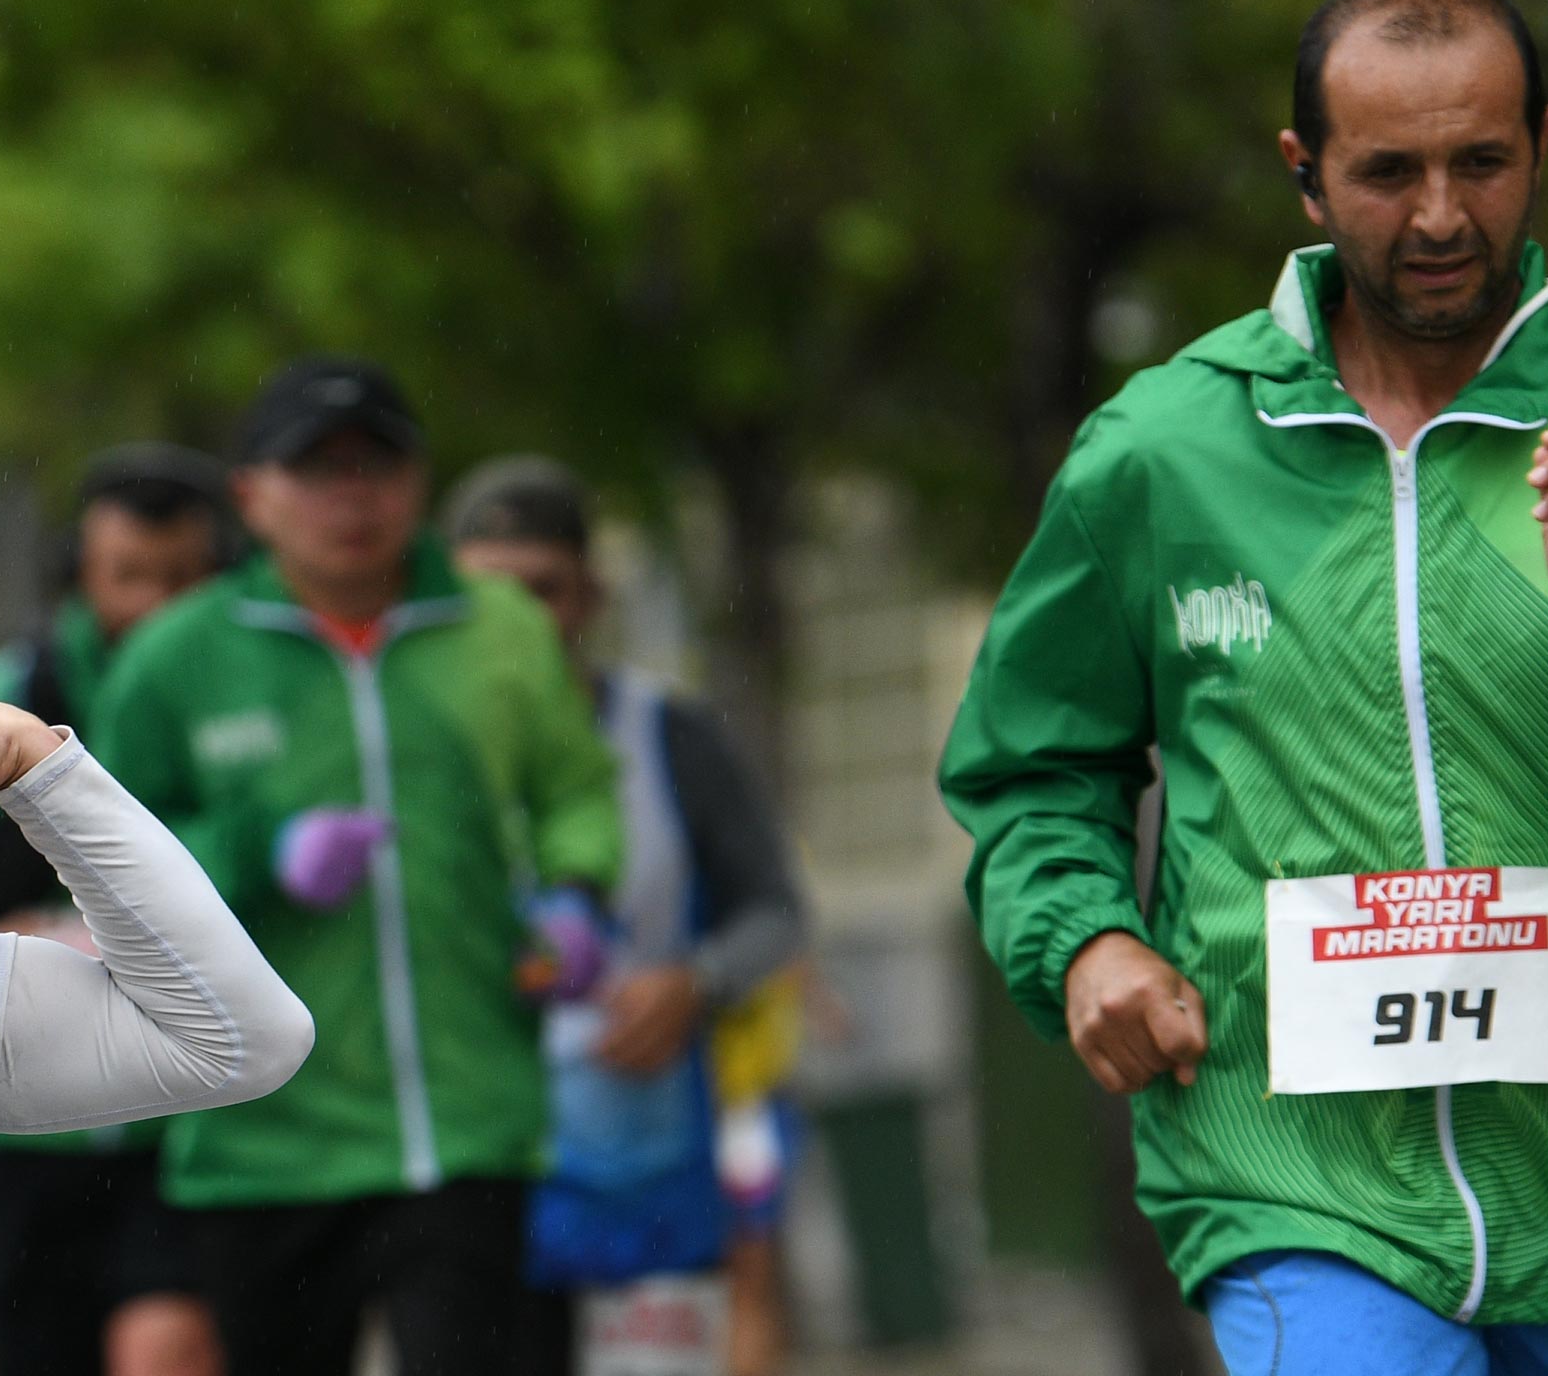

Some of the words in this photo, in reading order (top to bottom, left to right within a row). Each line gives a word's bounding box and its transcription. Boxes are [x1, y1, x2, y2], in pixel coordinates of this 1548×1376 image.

[1366, 873, 1492, 903] KONYA
[1386, 899, 1473, 924] YARI
[1324, 921, 1537, 956] MARATONU
[1373, 987, 1496, 1045] 914
